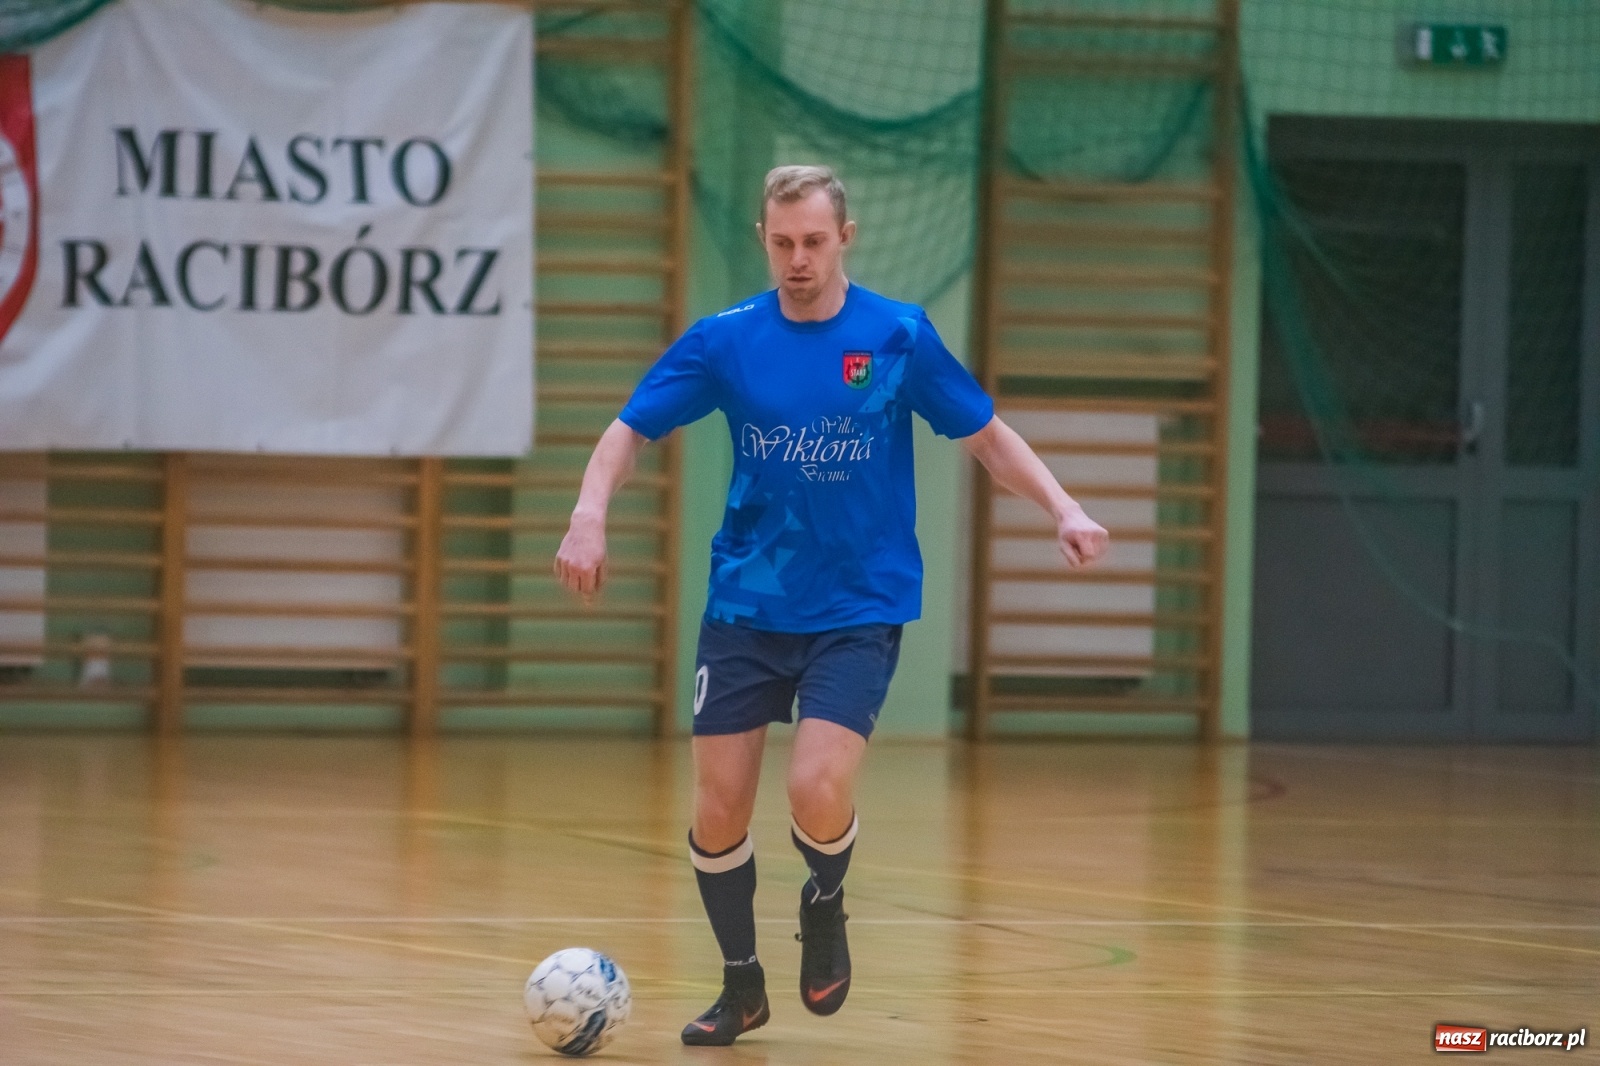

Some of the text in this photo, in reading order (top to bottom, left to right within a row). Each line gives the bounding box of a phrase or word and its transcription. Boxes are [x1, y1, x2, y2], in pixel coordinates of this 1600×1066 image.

[113, 126, 453, 207] MIASTO
[60, 224, 504, 316] RACIBÓRZ
[741, 422, 875, 462] Wiktoria
